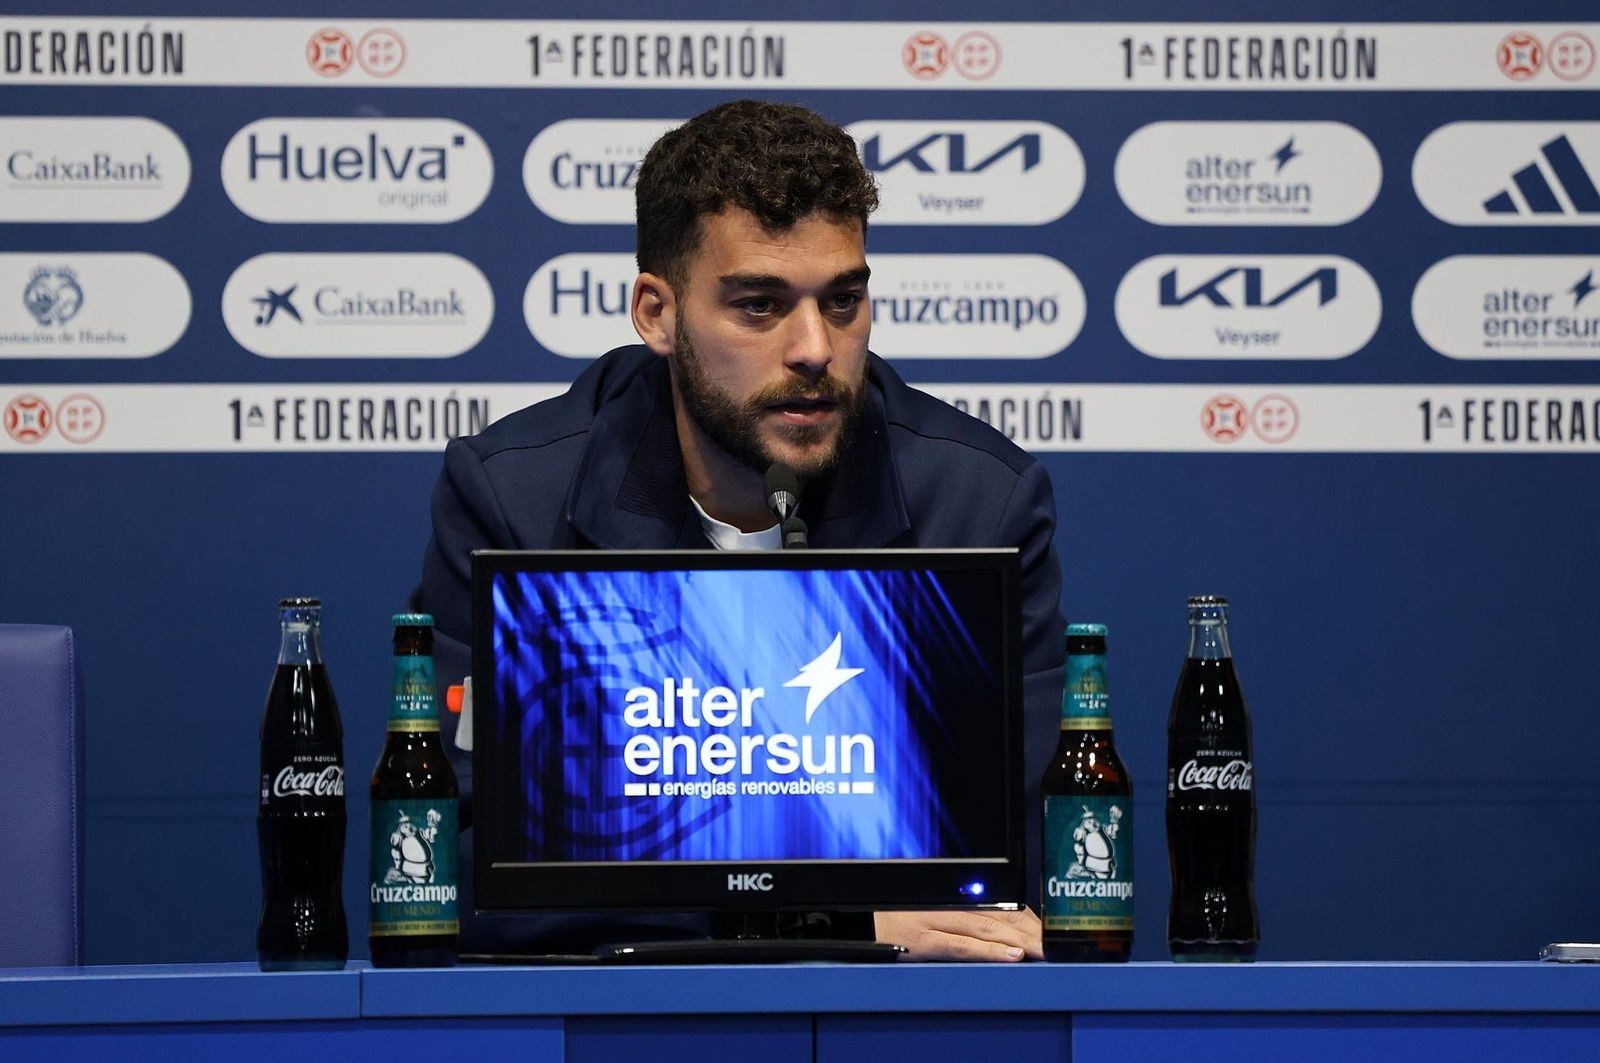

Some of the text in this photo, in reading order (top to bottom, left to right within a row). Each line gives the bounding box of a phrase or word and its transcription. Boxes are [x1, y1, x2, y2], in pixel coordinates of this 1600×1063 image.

[3, 24, 184, 75] DERACIÓN
[572, 28, 785, 79] FEDERACIÓN
[1164, 30, 1377, 81] FEDERACIÓN
[7, 151, 161, 182] CaixaBank
[249, 133, 446, 182] Huelva
[1185, 155, 1255, 180] alter
[378, 189, 447, 210] original
[918, 193, 985, 213] Veyser
[1185, 182, 1311, 204] enersun
[313, 286, 465, 317] CaixaBank
[1483, 289, 1553, 314] alter
[1215, 328, 1281, 348] Veyser
[274, 390, 489, 442] FEDERACIÓN
[623, 677, 765, 728] alter
[623, 733, 875, 776] enersun
[273, 765, 344, 798] Coca-Cola
[662, 778, 836, 799] energías renovables
[1178, 759, 1252, 791] Coca-Cola
[370, 882, 457, 905] Cruzcampo
[727, 872, 774, 892] HKC
[1048, 876, 1133, 901] Cruzcampo
